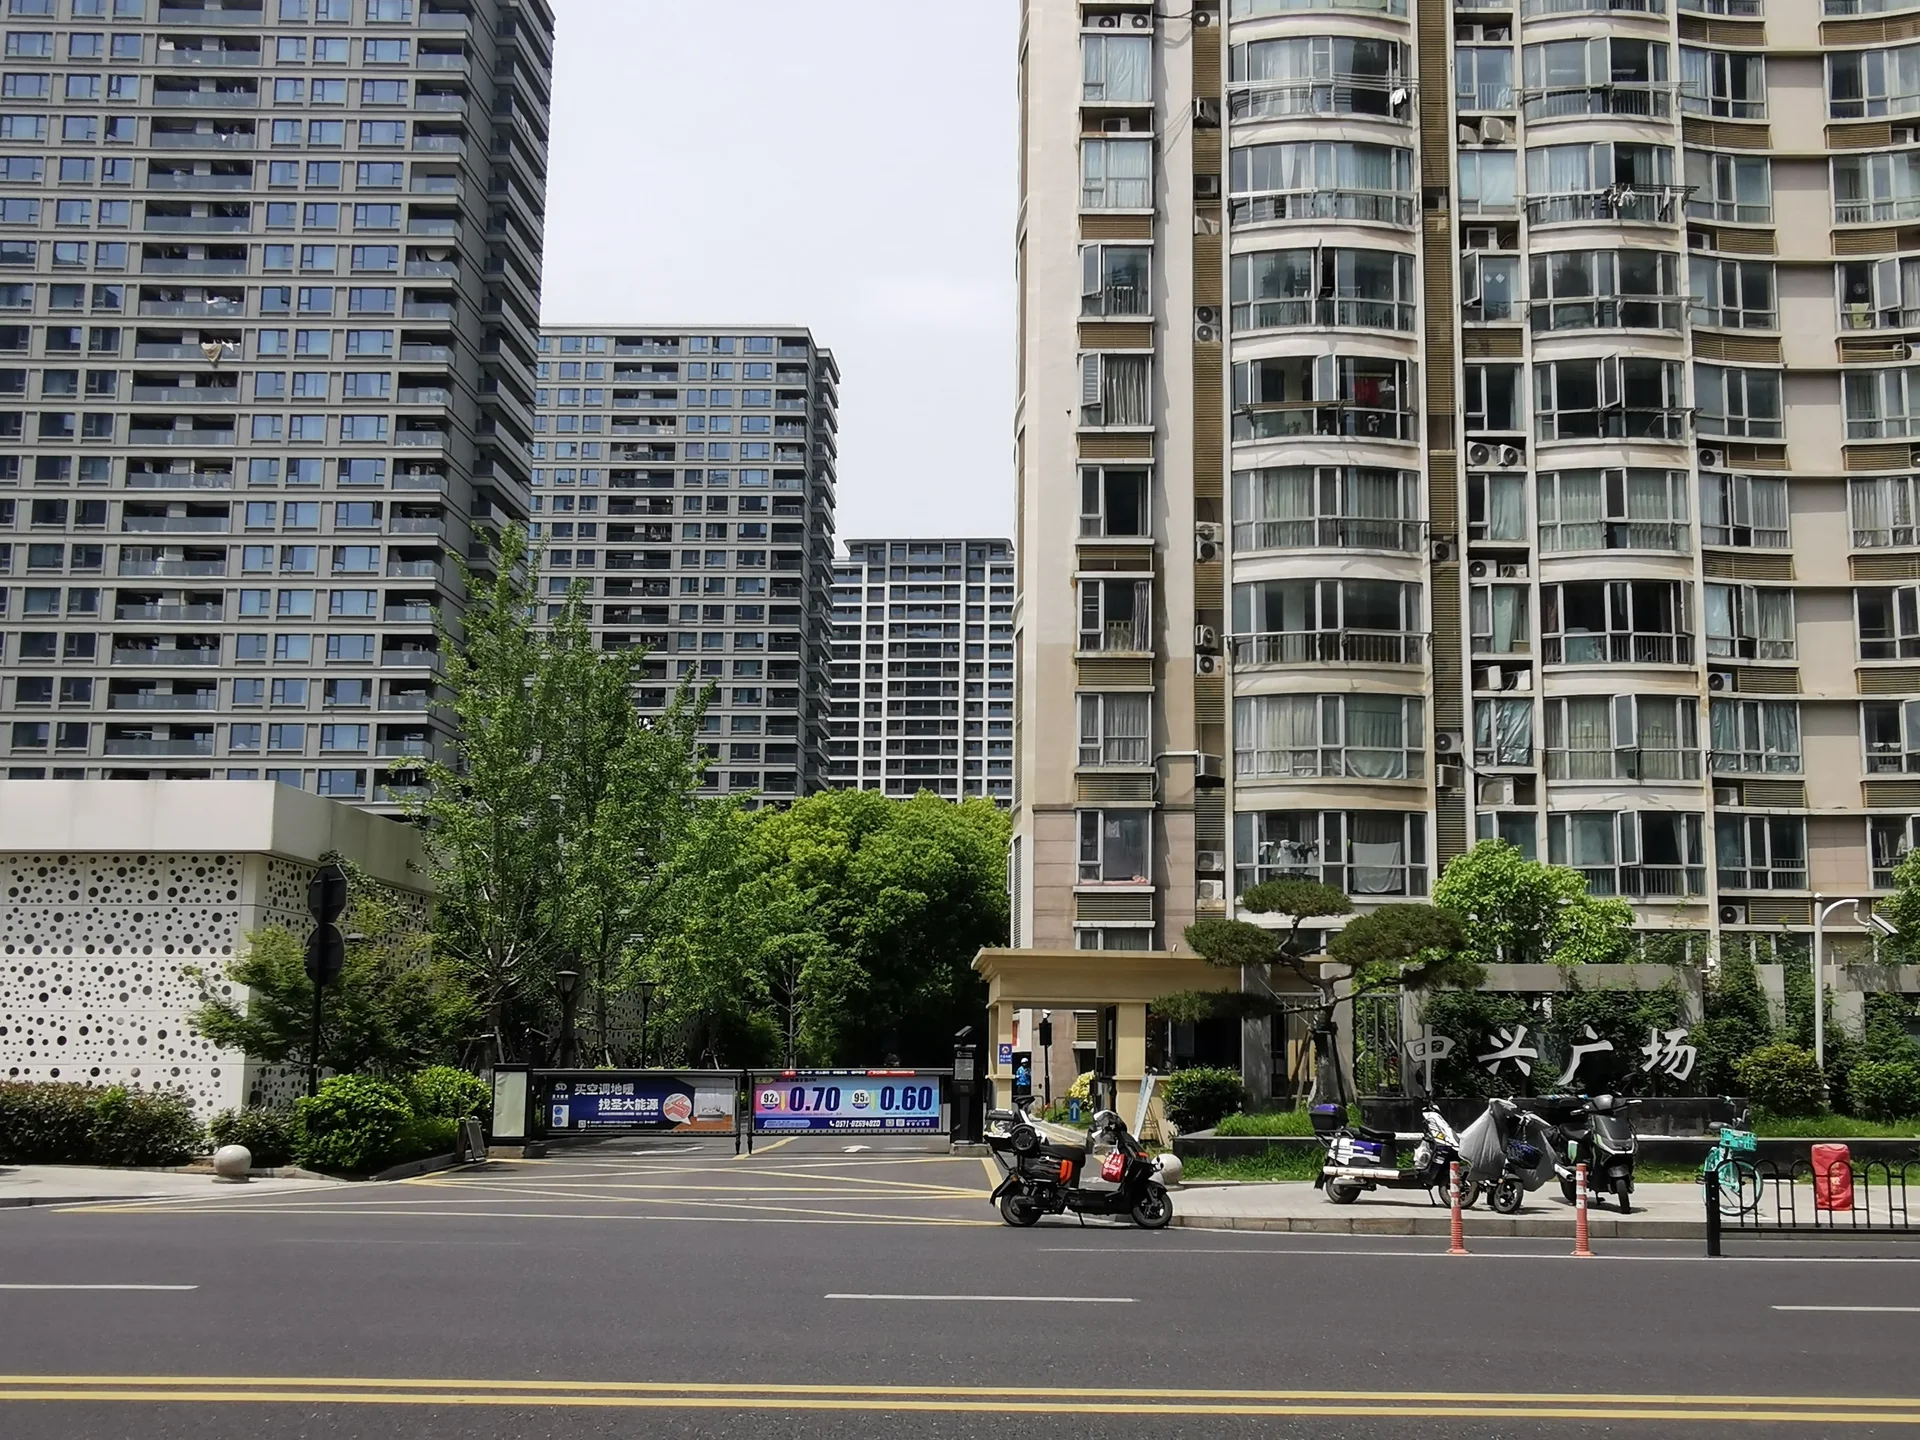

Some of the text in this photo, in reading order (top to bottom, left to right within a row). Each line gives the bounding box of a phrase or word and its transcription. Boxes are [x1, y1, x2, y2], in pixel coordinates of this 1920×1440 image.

[1404, 1024, 1697, 1091] 中兴广场
[574, 1083, 635, 1096] 买空调地暖
[789, 1086, 841, 1112] 0.70
[880, 1085, 933, 1111] 0.60
[598, 1098, 659, 1111] 找圣大能源
